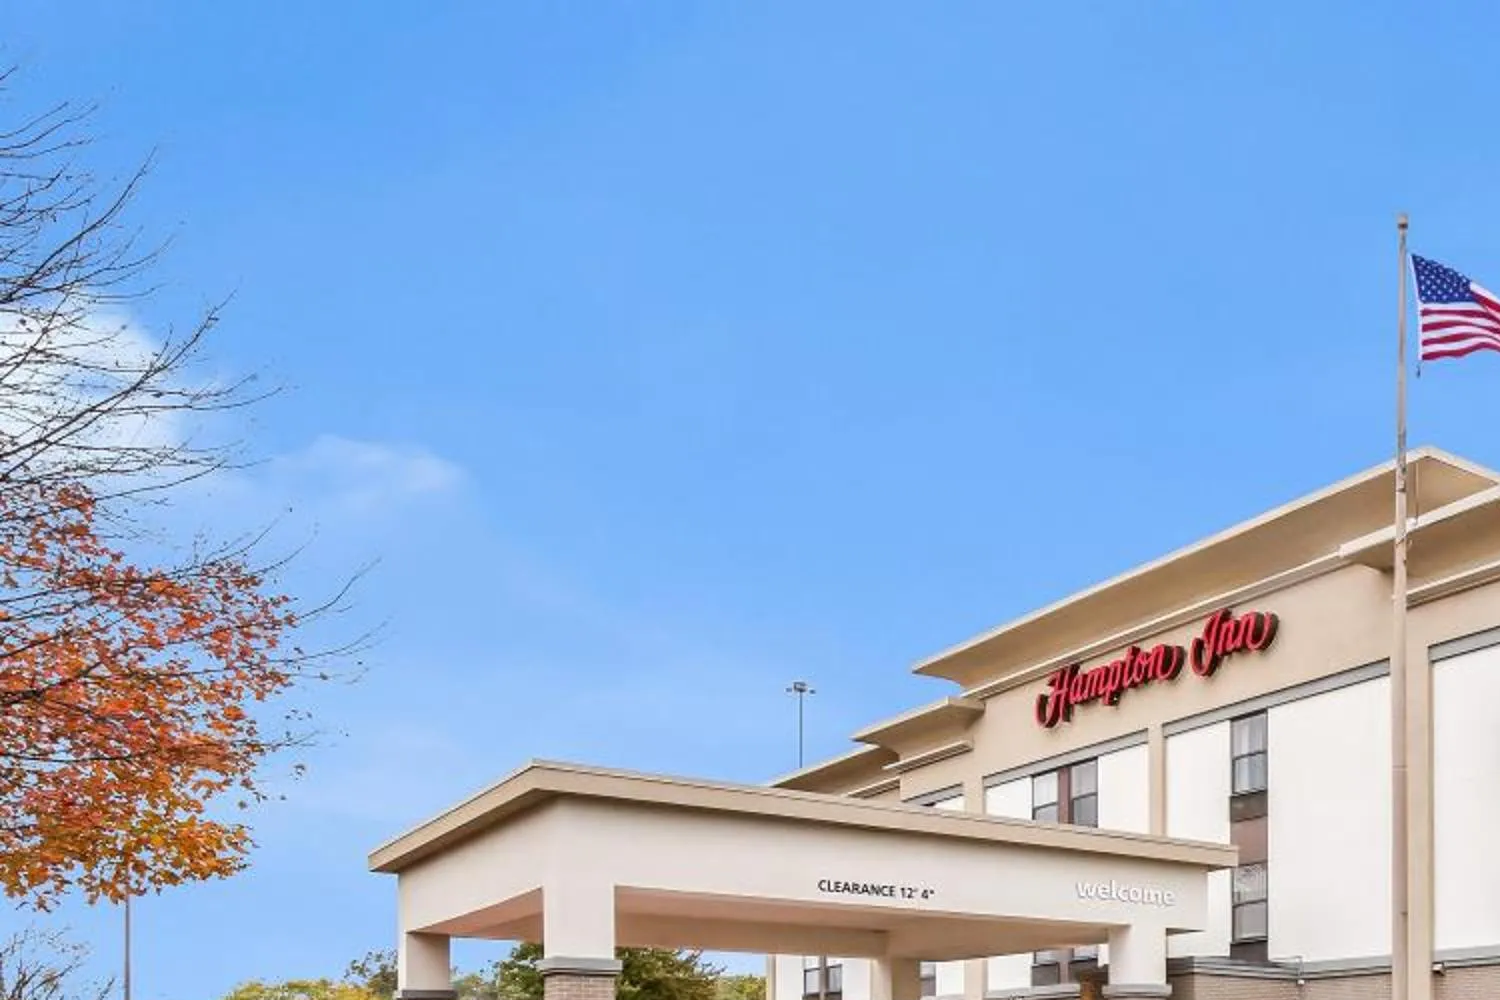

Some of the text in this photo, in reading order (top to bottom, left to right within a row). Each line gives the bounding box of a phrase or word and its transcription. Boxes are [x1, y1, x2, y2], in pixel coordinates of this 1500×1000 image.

[1035, 608, 1279, 728] Hampton Inn
[817, 879, 896, 897] CLEARANCE
[1075, 879, 1176, 906] welcome
